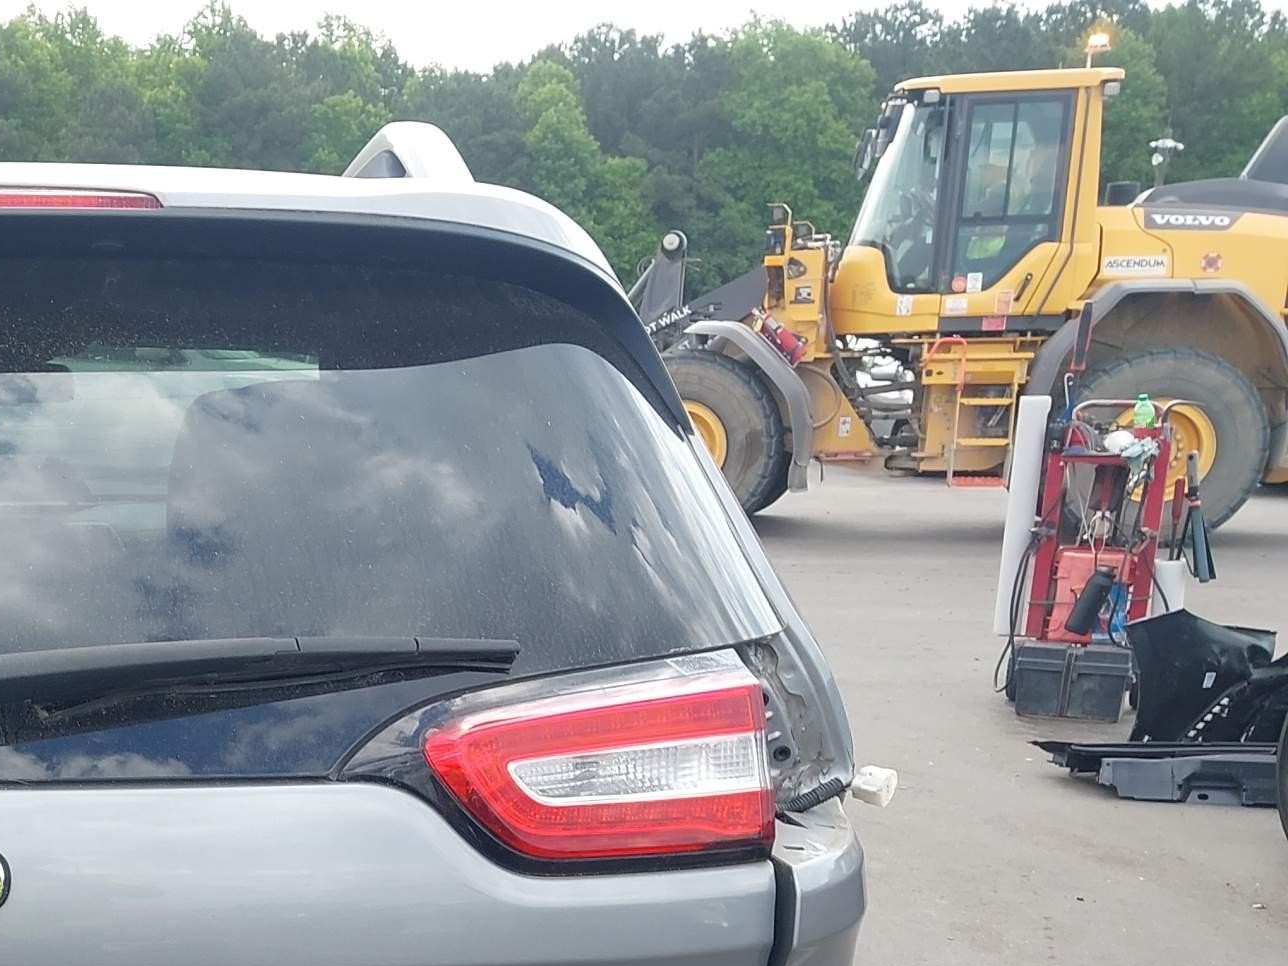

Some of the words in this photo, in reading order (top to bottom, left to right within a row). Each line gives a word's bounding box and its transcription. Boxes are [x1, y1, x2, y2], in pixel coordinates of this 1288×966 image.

[1151, 213, 1231, 226] VOLVO
[1105, 258, 1166, 269] ASCENDUM
[658, 304, 692, 327] WALK
